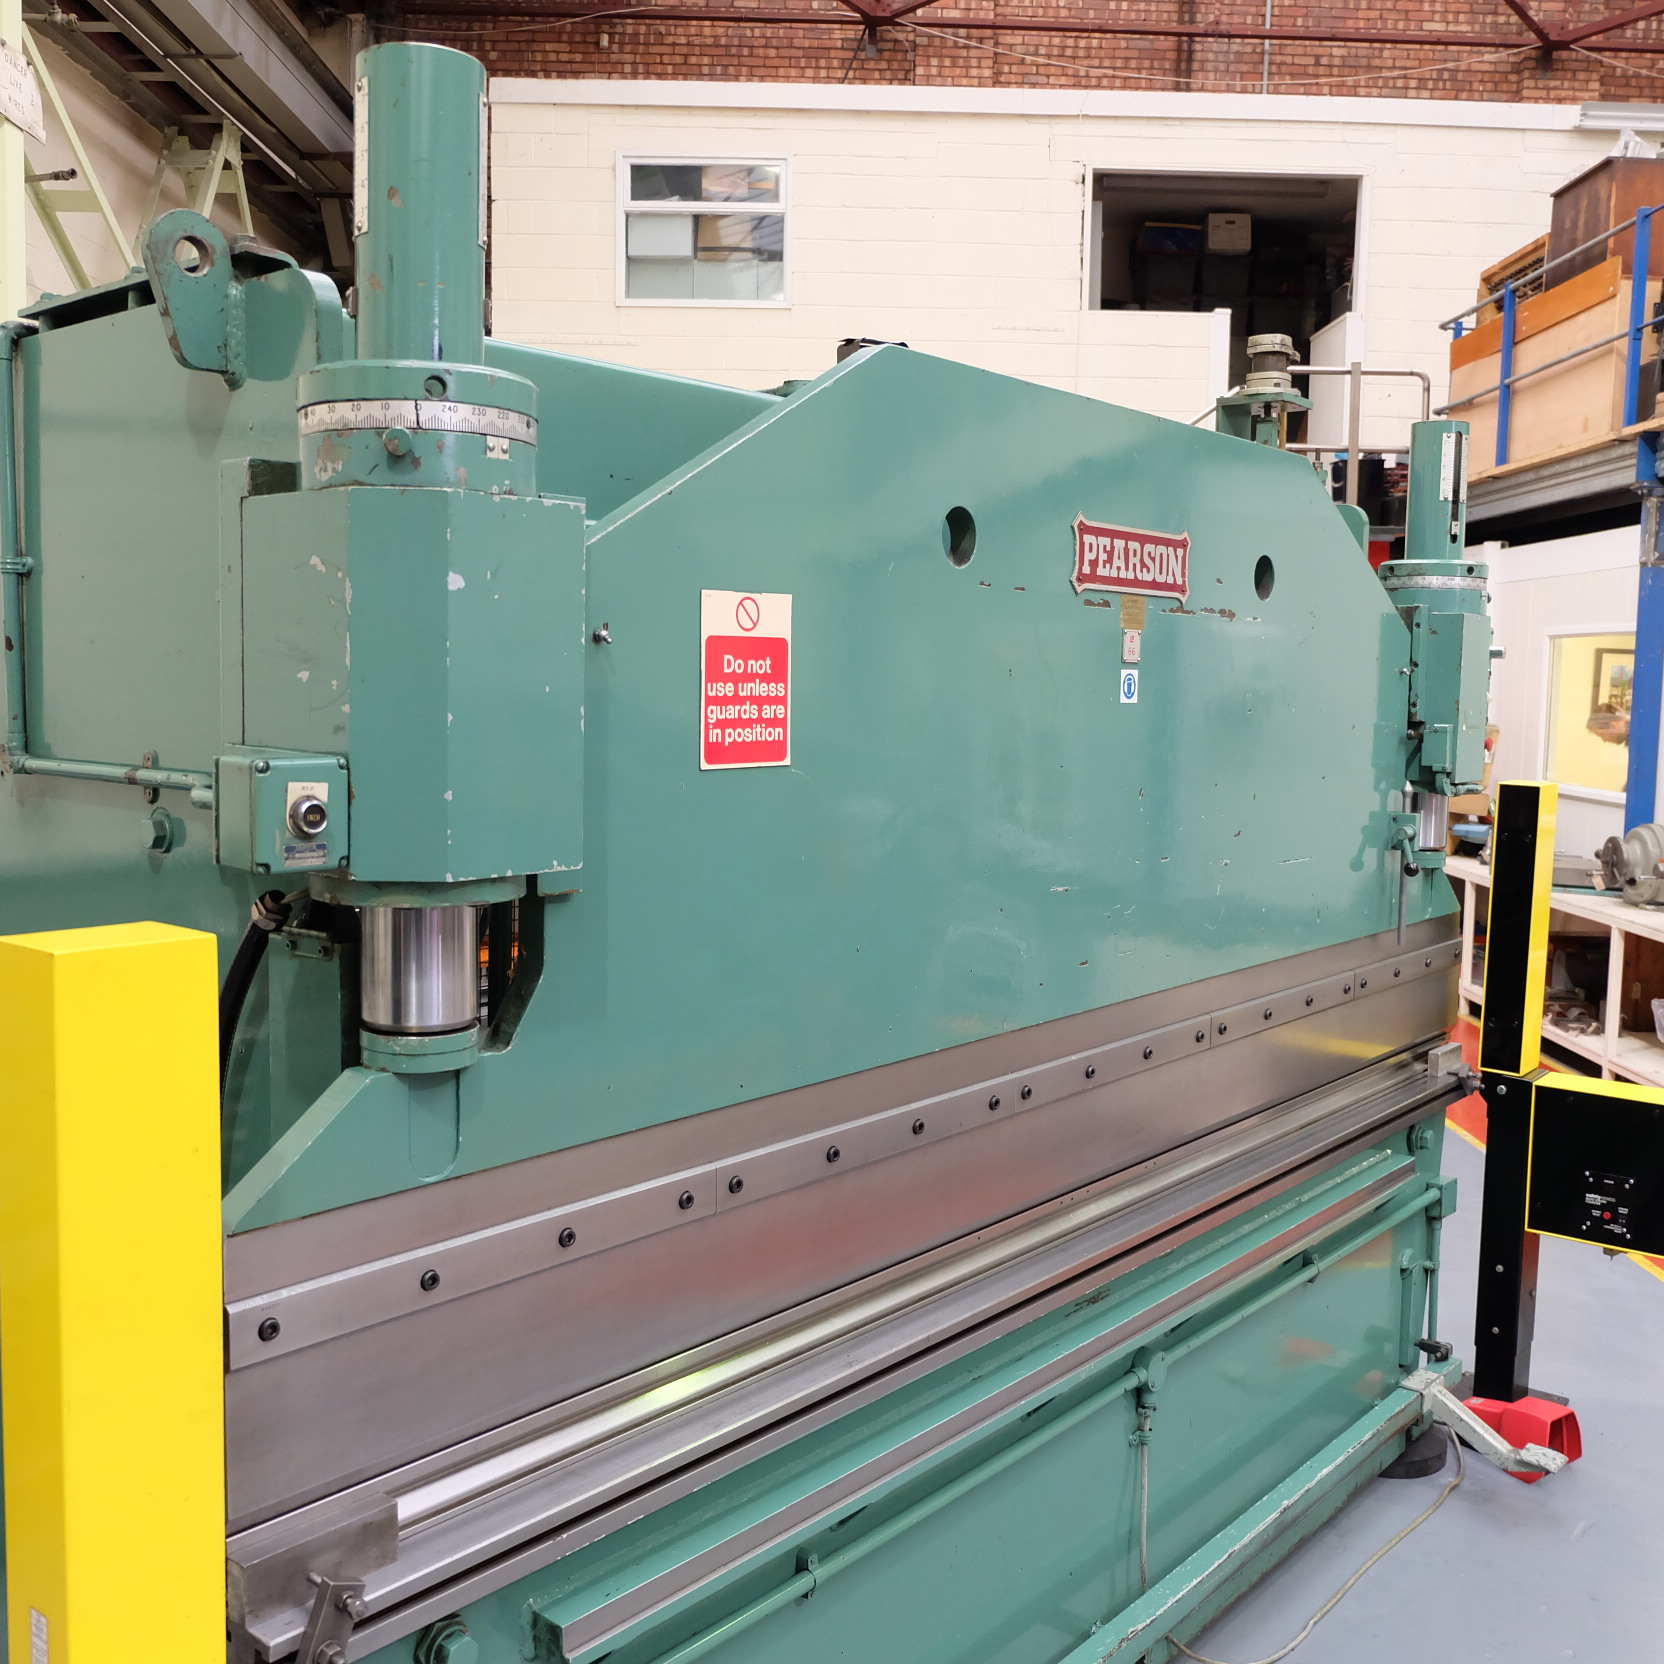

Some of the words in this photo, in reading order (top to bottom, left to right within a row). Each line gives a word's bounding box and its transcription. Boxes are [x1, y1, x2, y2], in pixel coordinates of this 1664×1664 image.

[327, 404, 336, 414] 30
[351, 403, 362, 412] 20
[380, 402, 390, 411] 10
[442, 404, 459, 414] 240
[472, 407, 487, 417] 230
[497, 411, 510, 421] 220
[1082, 534, 1184, 585] PEARSON
[723, 654, 744, 674] Do
[747, 656, 771, 674] not
[707, 681, 735, 697] use
[738, 678, 785, 697] unless
[707, 701, 758, 723] guards
[761, 704, 785, 719] are
[709, 725, 722, 743] in
[724, 723, 784, 746] position
